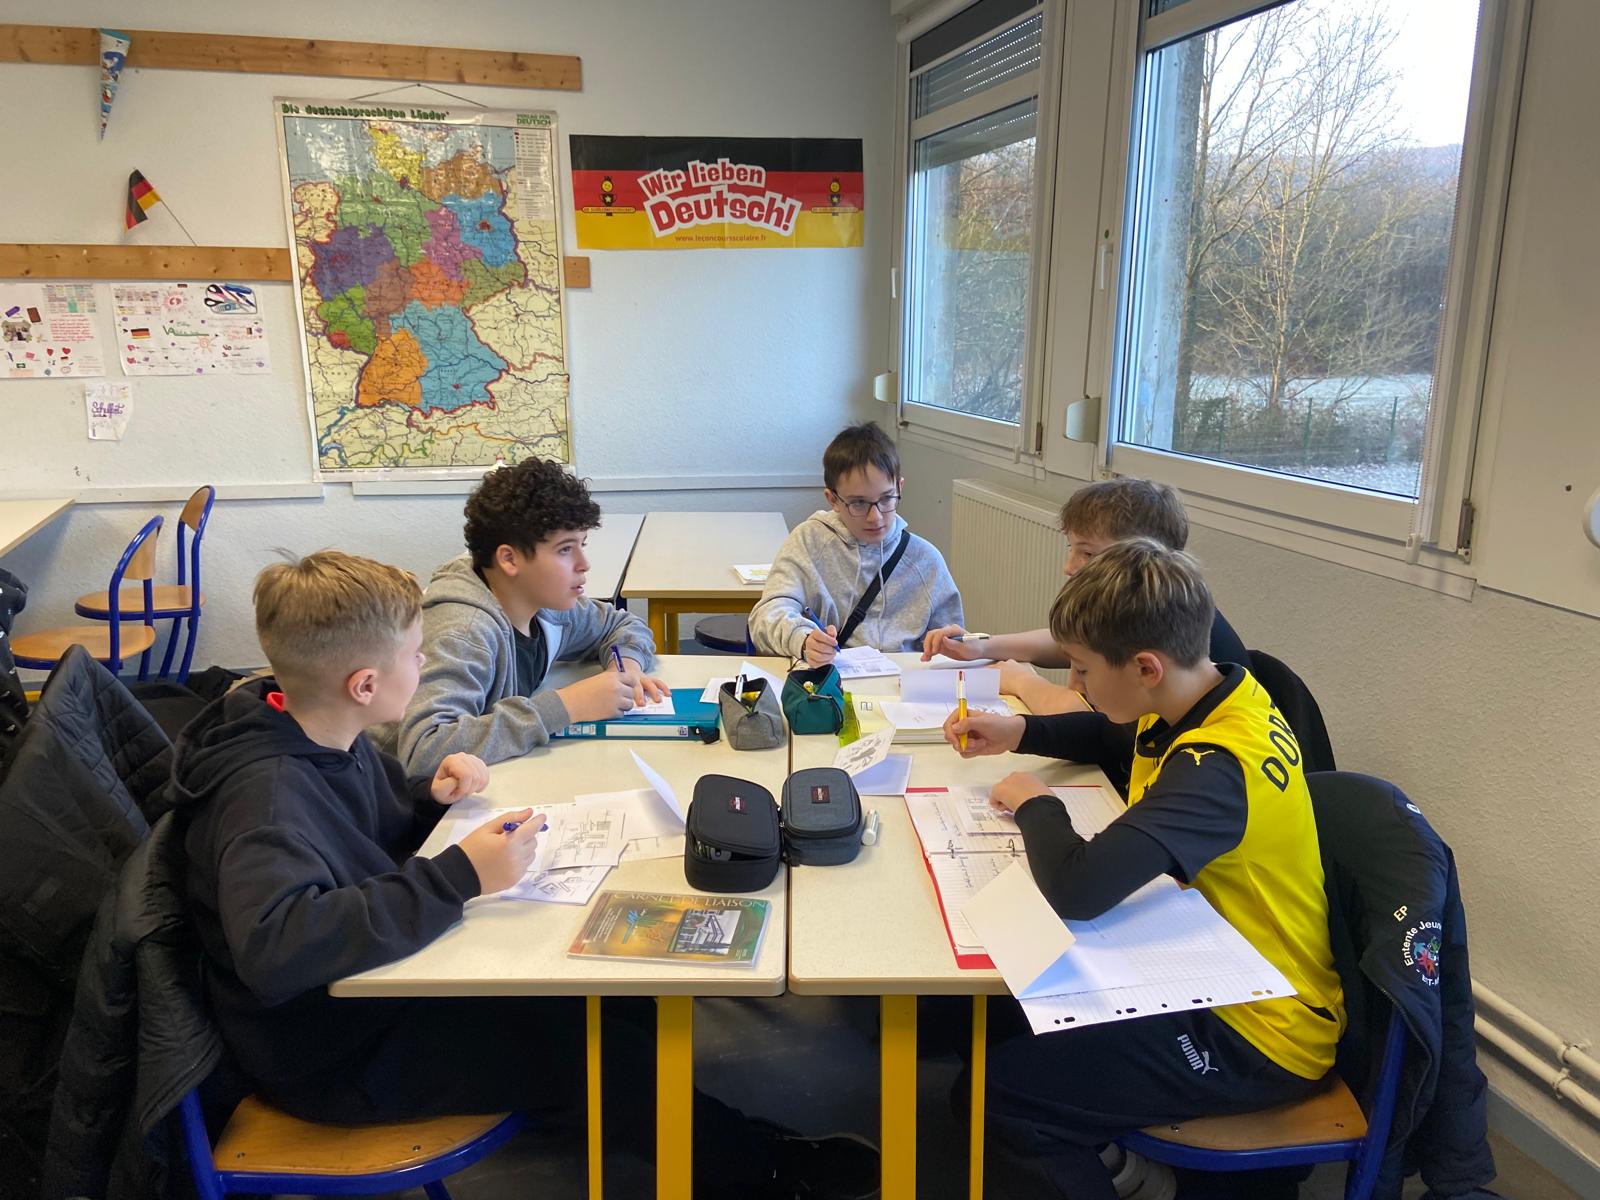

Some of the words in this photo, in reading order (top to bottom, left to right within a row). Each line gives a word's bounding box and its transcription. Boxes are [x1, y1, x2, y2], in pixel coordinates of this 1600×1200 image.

[642, 173, 683, 197] Wir
[691, 162, 764, 185] lieben
[649, 189, 797, 232] Deutsch!
[1261, 701, 1300, 793] DOR
[614, 893, 674, 904] CARNET
[684, 896, 703, 905] DE
[705, 898, 766, 908] LIAISON
[1393, 905, 1408, 922] EP
[1402, 927, 1418, 967] Entente
[1177, 1034, 1204, 1070] PUMA
